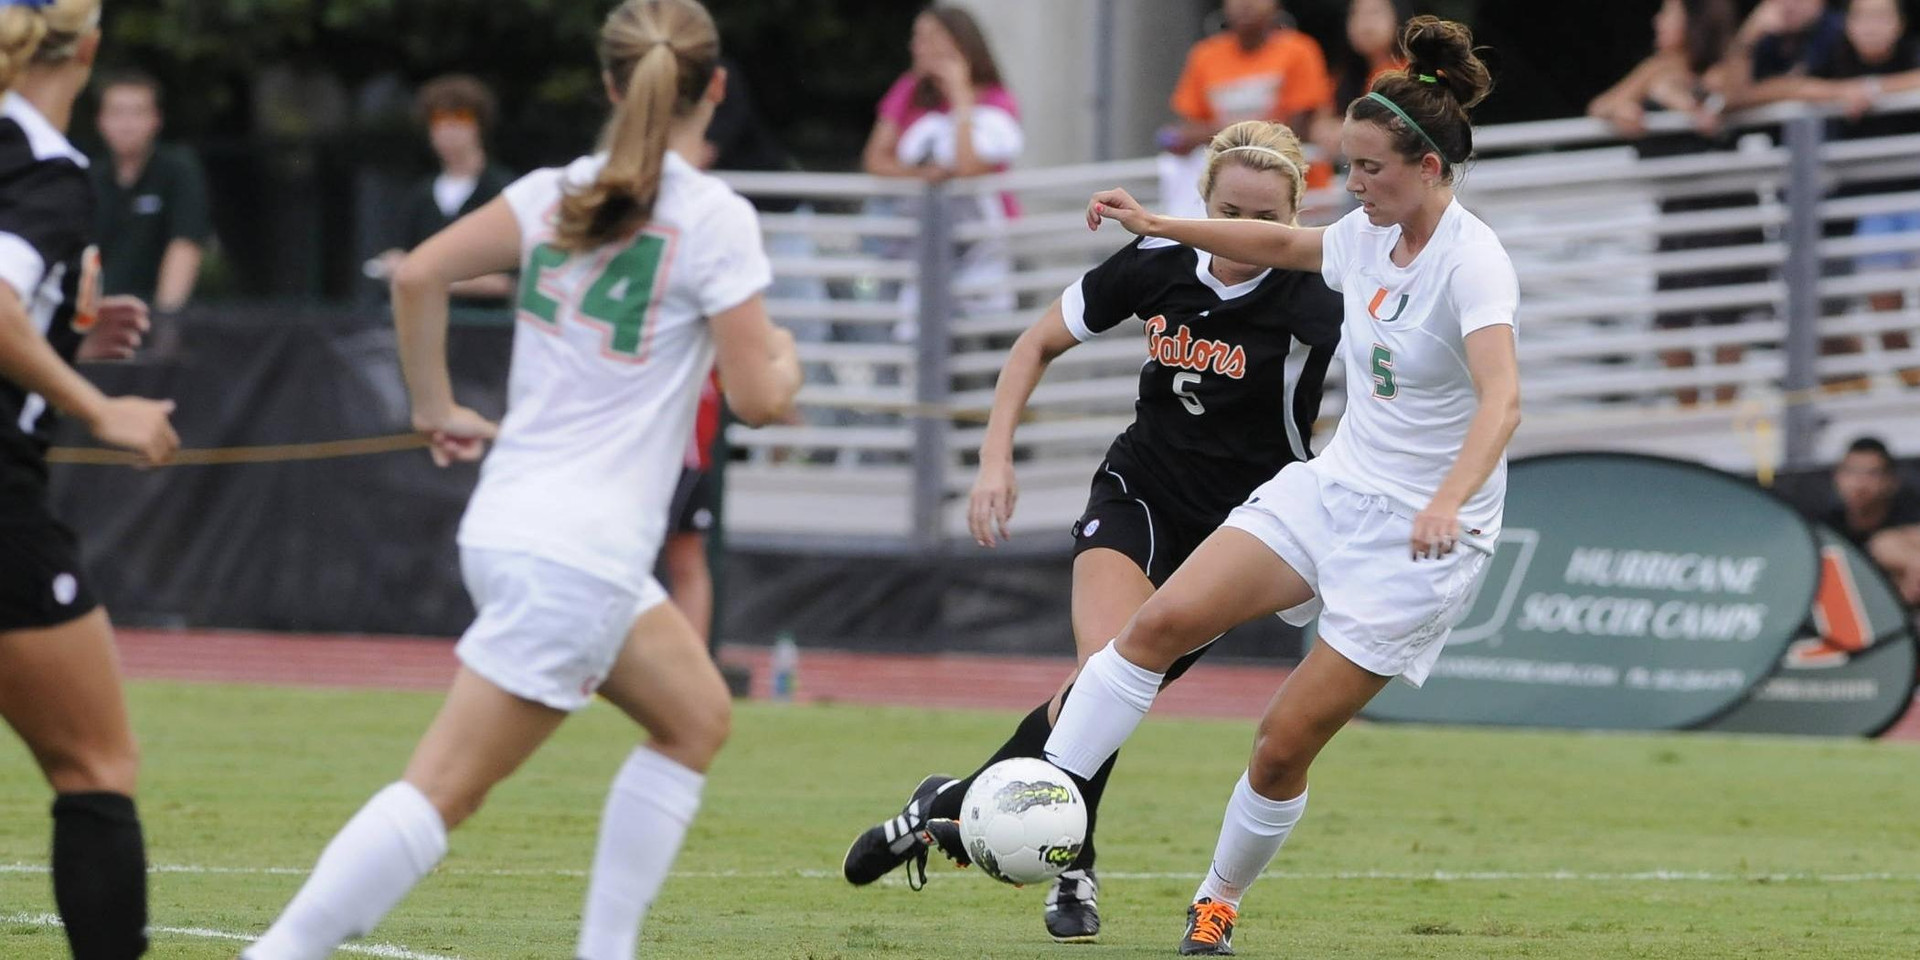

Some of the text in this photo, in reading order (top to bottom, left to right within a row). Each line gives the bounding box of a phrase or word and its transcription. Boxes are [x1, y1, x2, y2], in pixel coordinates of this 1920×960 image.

[1145, 314, 1246, 379] Gators
[1369, 342, 1399, 401] 5
[1172, 371, 1206, 416] 5
[1564, 547, 1767, 594] HURRICANE
[1518, 592, 1768, 642] SOCCER CAMPS
